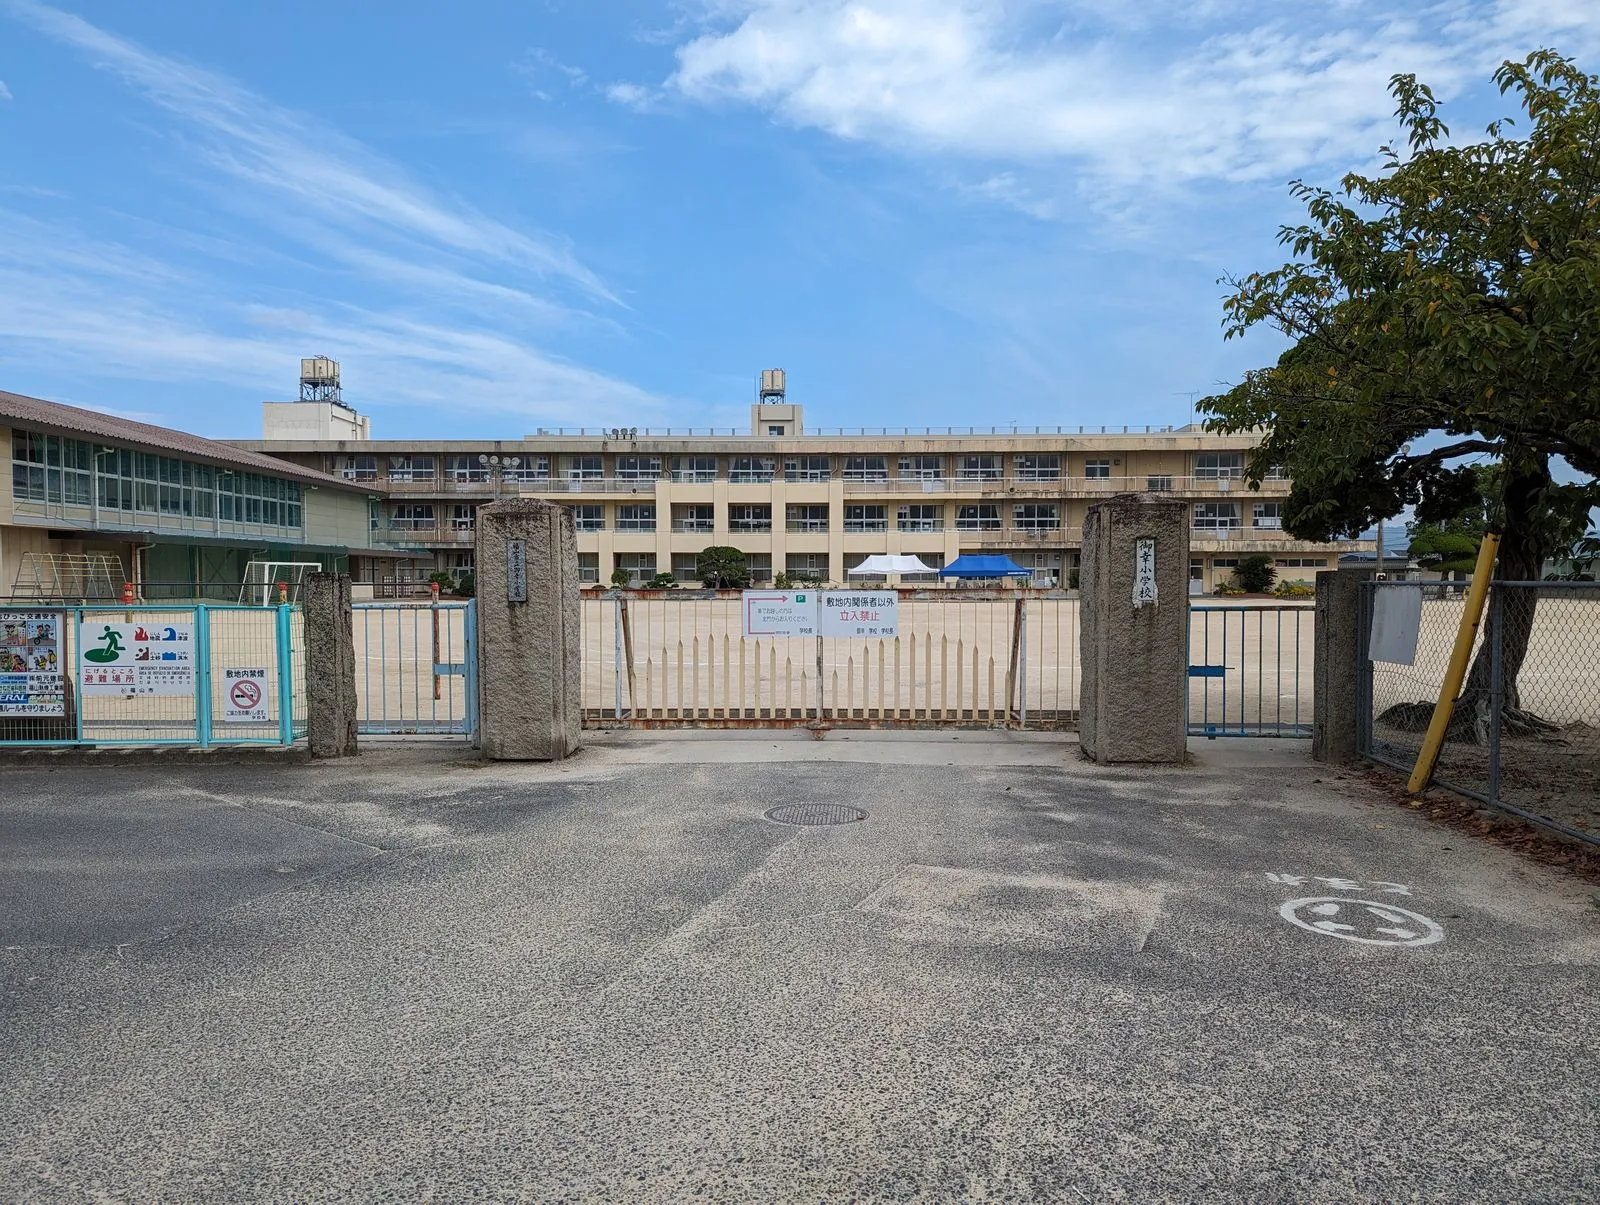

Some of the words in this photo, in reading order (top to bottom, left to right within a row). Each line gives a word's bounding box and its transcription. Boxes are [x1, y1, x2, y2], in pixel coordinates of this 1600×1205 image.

[1138, 540, 1153, 599] 御幸小学校
[826, 597, 895, 608] 敷地内関係者以外
[840, 610, 880, 622] 立入禁止
[84, 674, 134, 683] 避難場所
[226, 670, 264, 678] 敷地内禁煙
